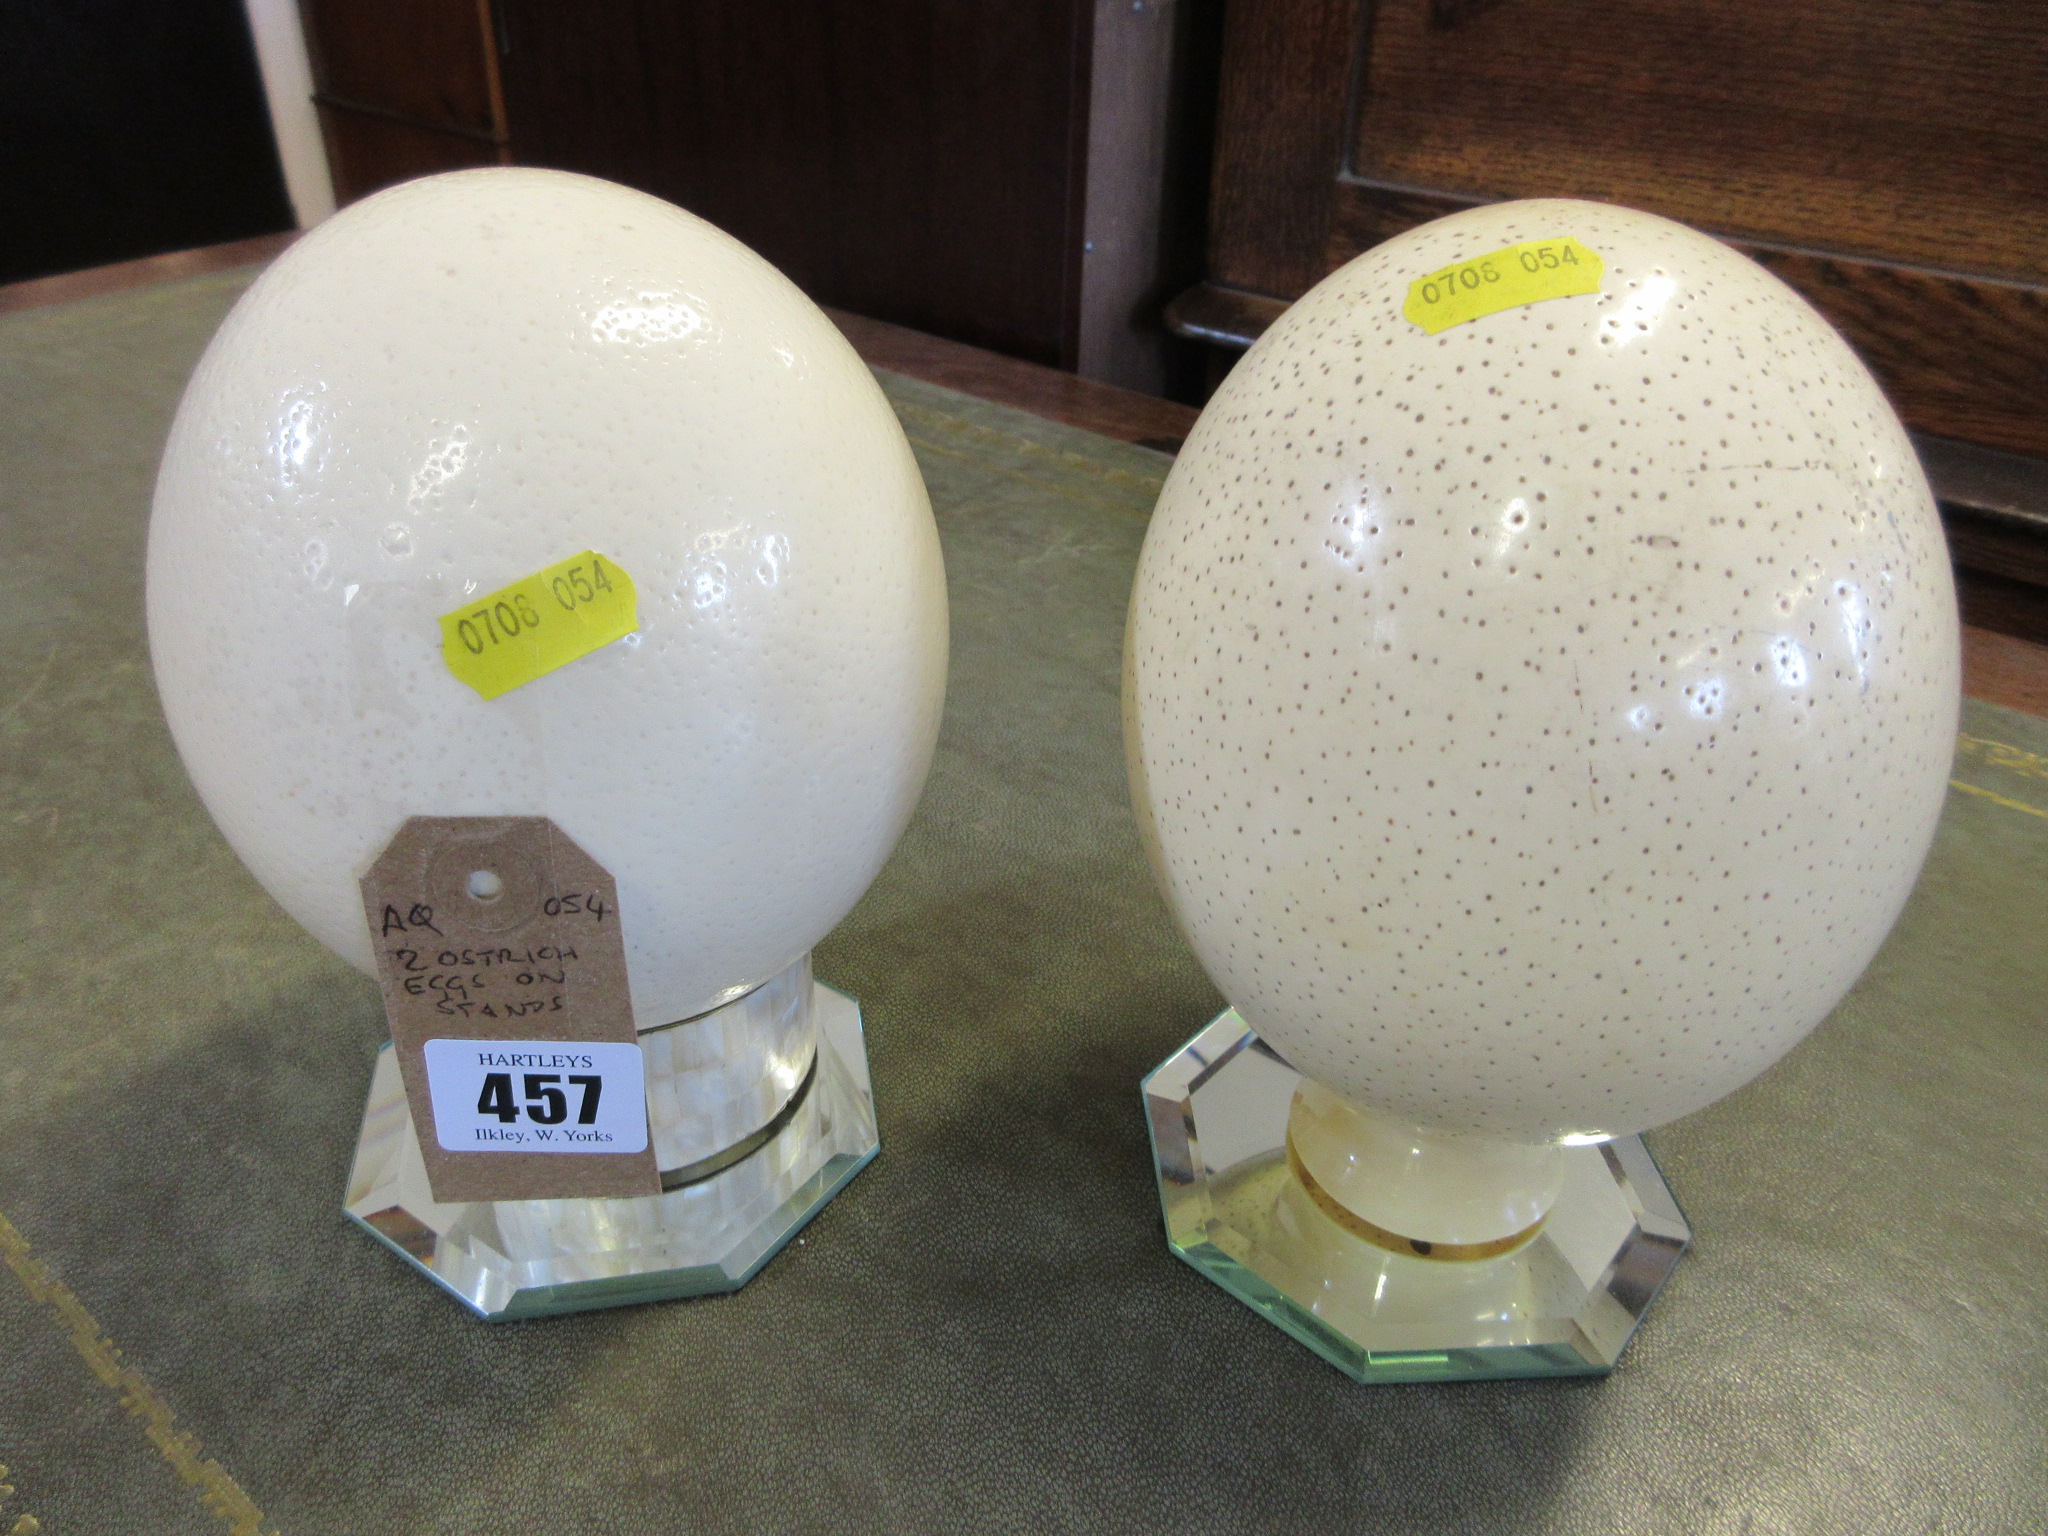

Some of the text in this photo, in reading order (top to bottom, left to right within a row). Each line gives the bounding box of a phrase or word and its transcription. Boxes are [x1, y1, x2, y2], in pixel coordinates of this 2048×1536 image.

[1520, 245, 1579, 273] 054
[552, 560, 613, 611] 054
[382, 894, 612, 937] AQ 054
[396, 946, 578, 971] 2 OSTRICH
[404, 971, 565, 999] EGGS ON
[436, 996, 563, 1018] STANDS
[478, 1053, 593, 1068] HARTLEYS
[477, 1072, 603, 1125] 457
[475, 1128, 613, 1144] Ilkley, W. Yorks
